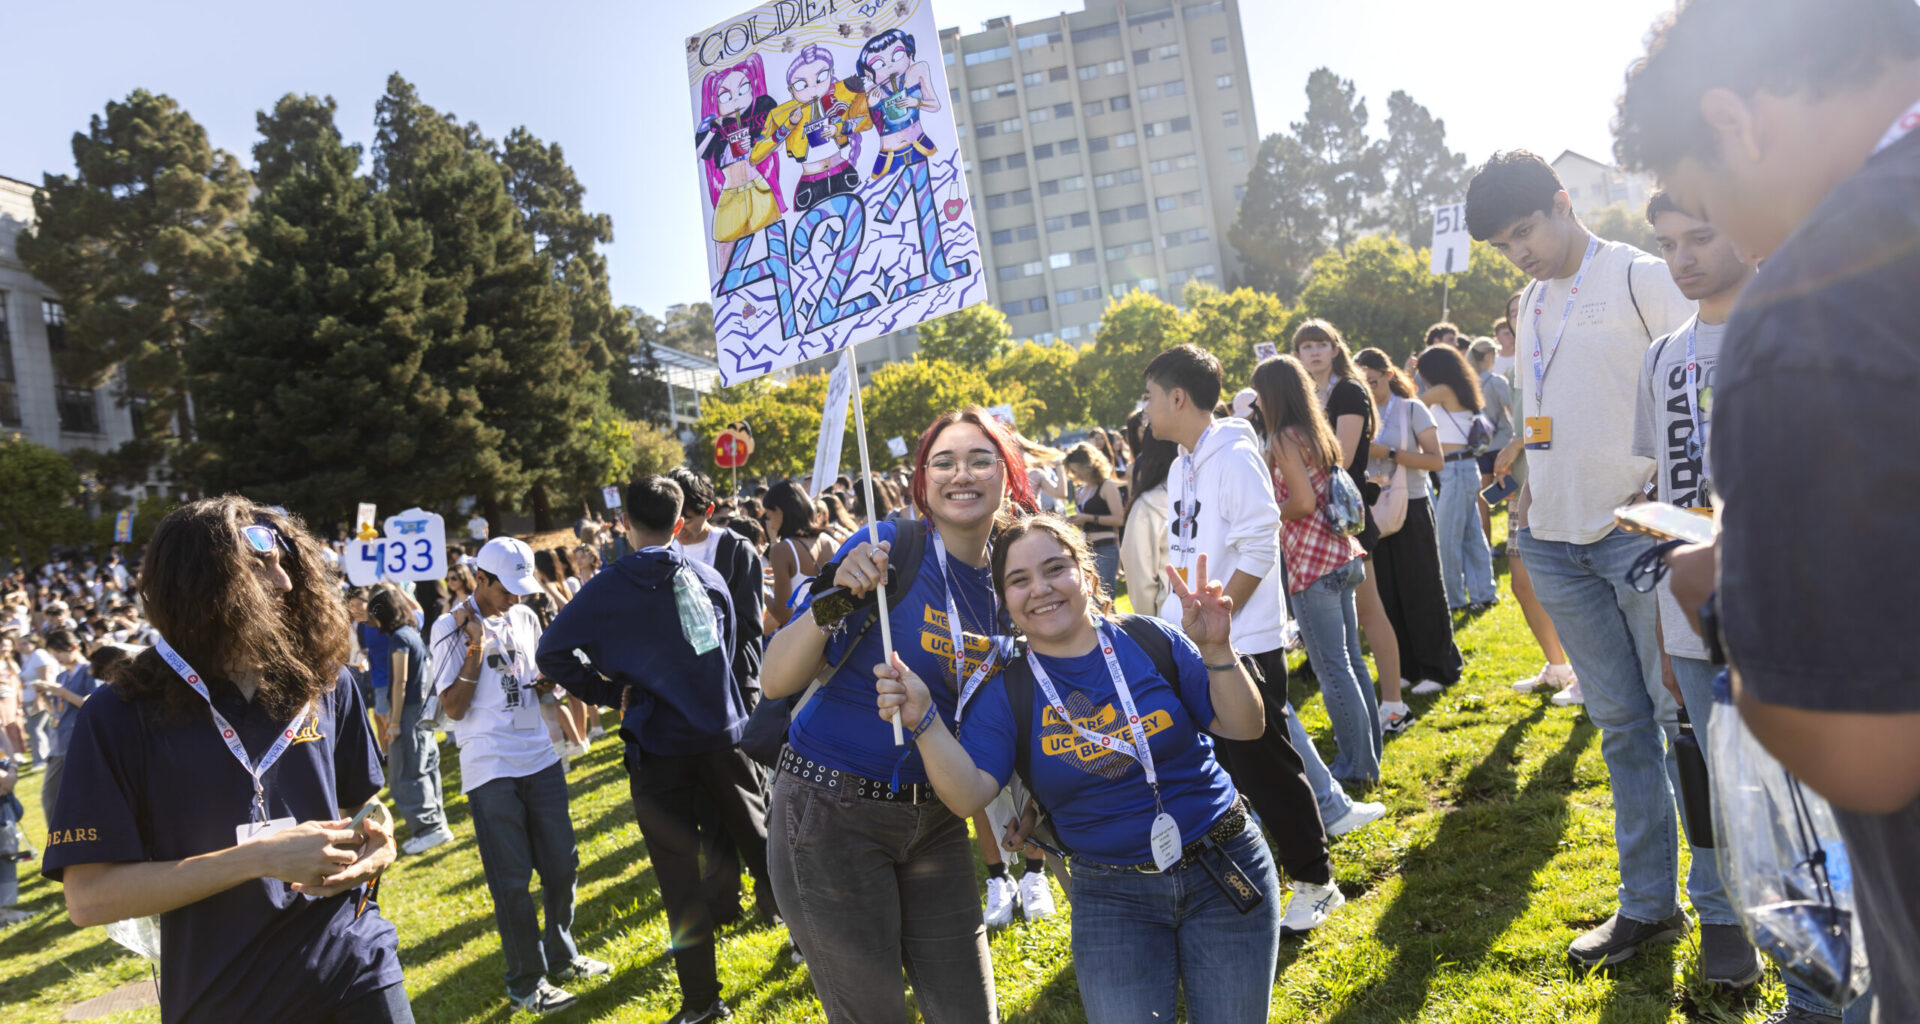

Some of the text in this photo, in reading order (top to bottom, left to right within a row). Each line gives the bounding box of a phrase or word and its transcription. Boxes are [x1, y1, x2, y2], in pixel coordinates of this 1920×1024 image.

[699, 0, 863, 66] GOLDE
[1436, 205, 1467, 235] 51
[717, 157, 971, 341] 421
[361, 539, 433, 578] 433
[931, 637, 949, 653] UC
[292, 716, 325, 745] al
[1078, 715, 1106, 730] ARE
[1080, 715, 1159, 758] BEKEEY
[1050, 737, 1072, 752] UC
